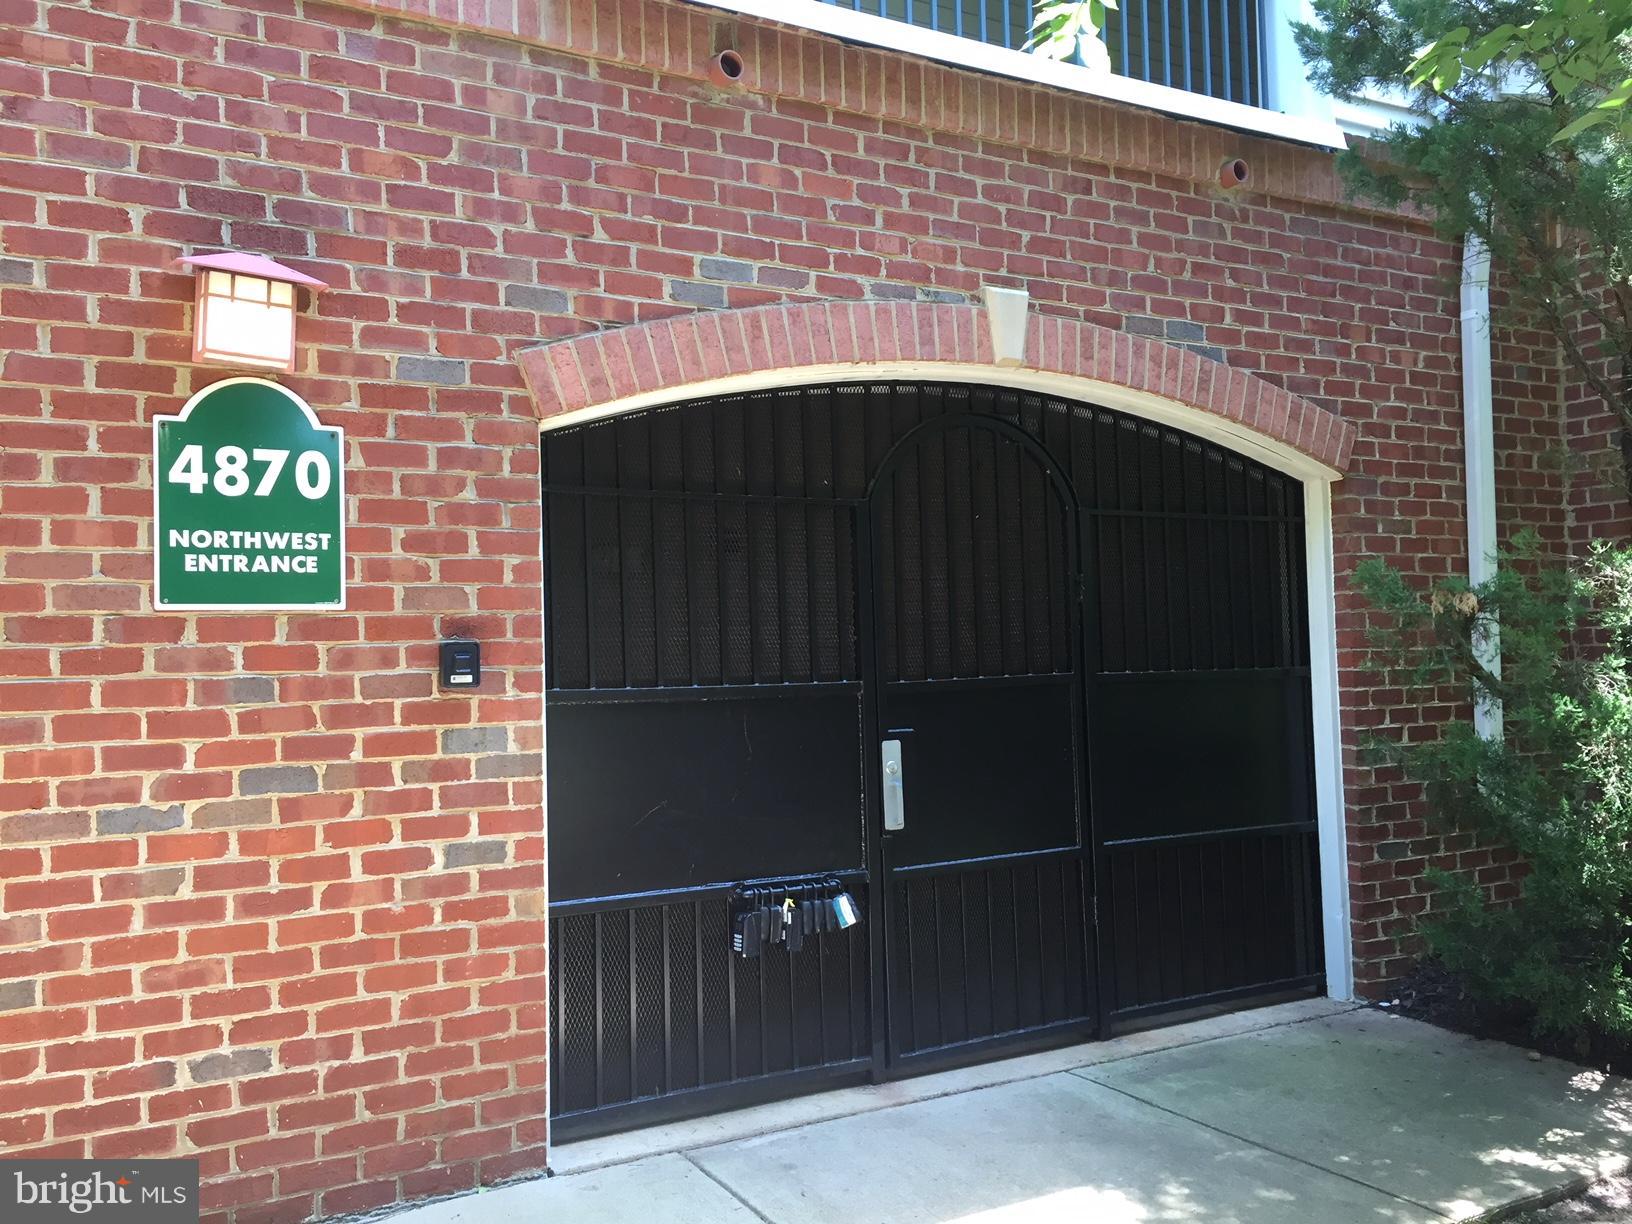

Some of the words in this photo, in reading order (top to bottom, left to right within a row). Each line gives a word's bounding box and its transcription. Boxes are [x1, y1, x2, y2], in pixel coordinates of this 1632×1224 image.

[168, 444, 331, 500] 4870
[169, 529, 331, 551] NORTHWEST
[184, 554, 318, 573] ENTRANCE
